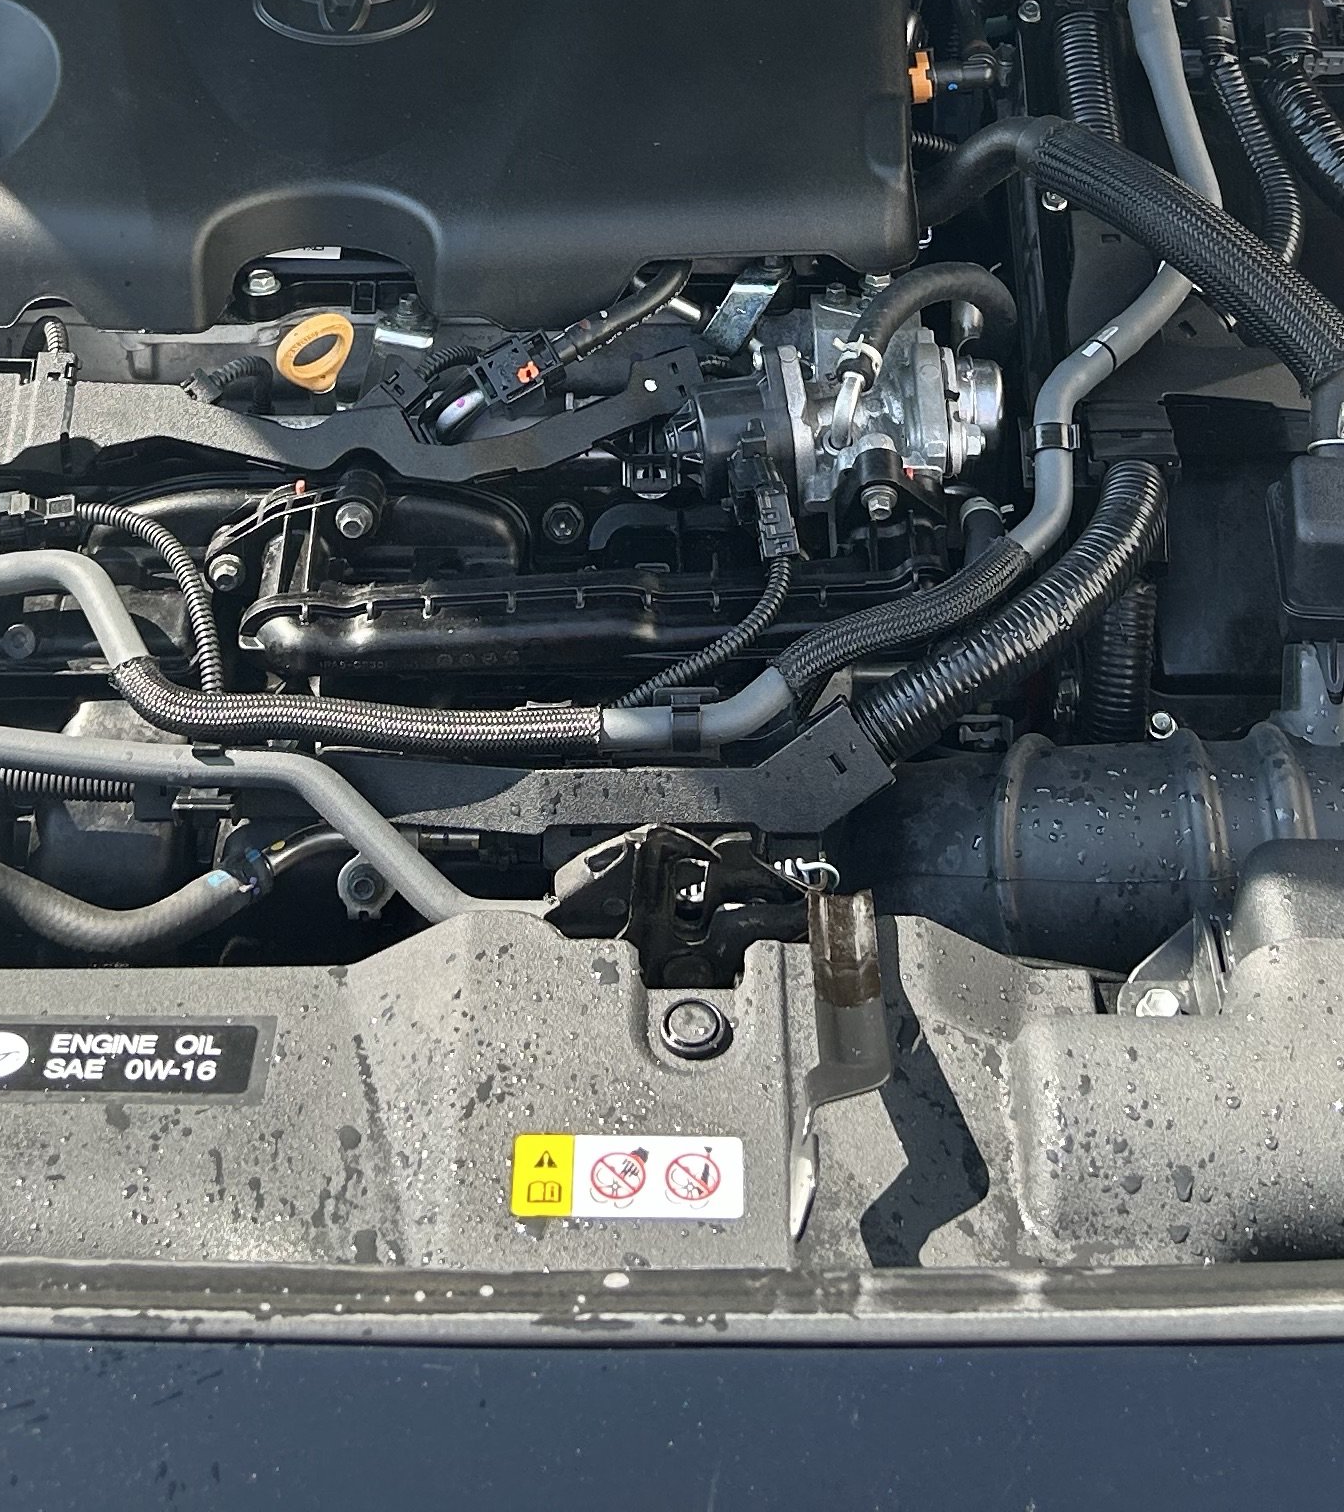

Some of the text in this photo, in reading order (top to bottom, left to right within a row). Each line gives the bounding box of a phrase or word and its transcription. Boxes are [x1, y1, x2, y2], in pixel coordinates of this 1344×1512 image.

[49, 1034, 222, 1055] ENGINE OIL
[43, 1058, 218, 1081] SAE 0W-16
